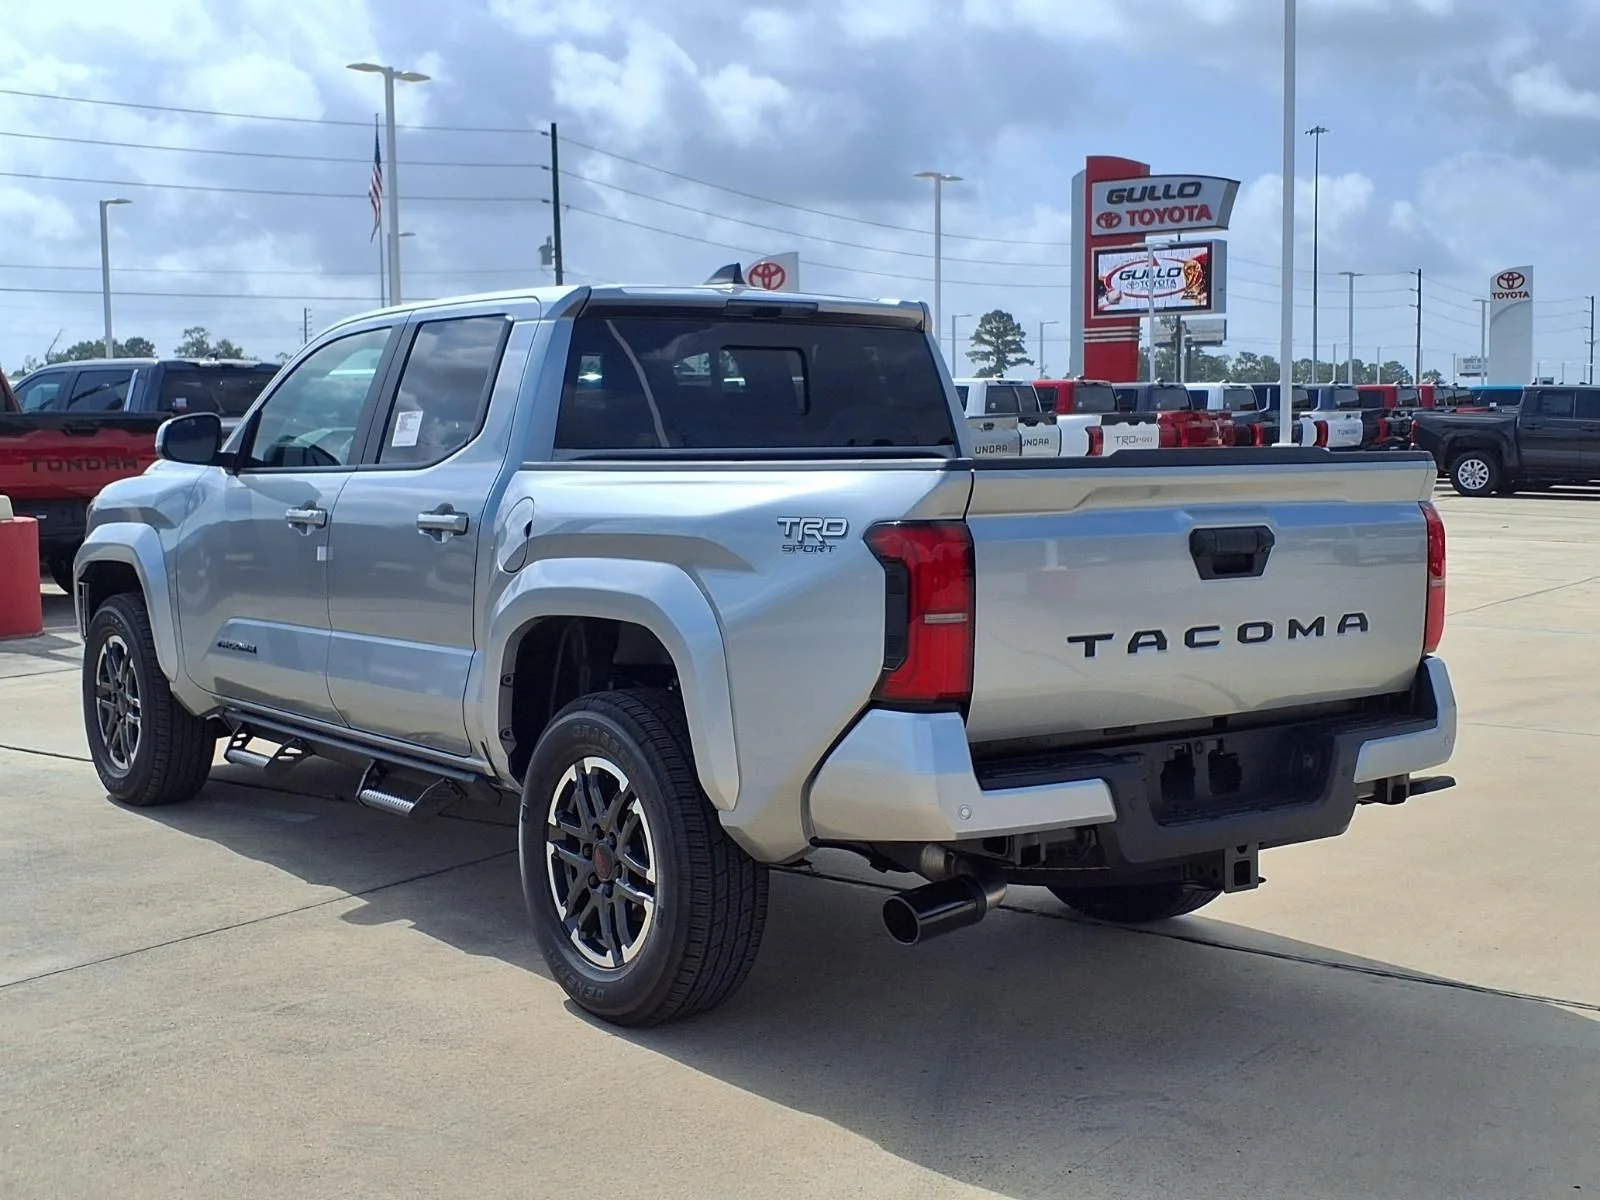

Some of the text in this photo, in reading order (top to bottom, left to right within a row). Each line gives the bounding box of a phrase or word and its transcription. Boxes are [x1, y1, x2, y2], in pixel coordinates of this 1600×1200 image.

[1106, 181, 1202, 205] GULLO
[1126, 204, 1212, 226] TOYOTA
[1491, 291, 1530, 300] TOYOTA
[974, 444, 1008, 455] UNDRA
[1022, 438, 1050, 447] UNDRA
[29, 456, 138, 473] TUNDRA
[777, 516, 849, 543] TRD
[781, 544, 838, 553] SPORT
[1066, 611, 1370, 658] TACOMA
